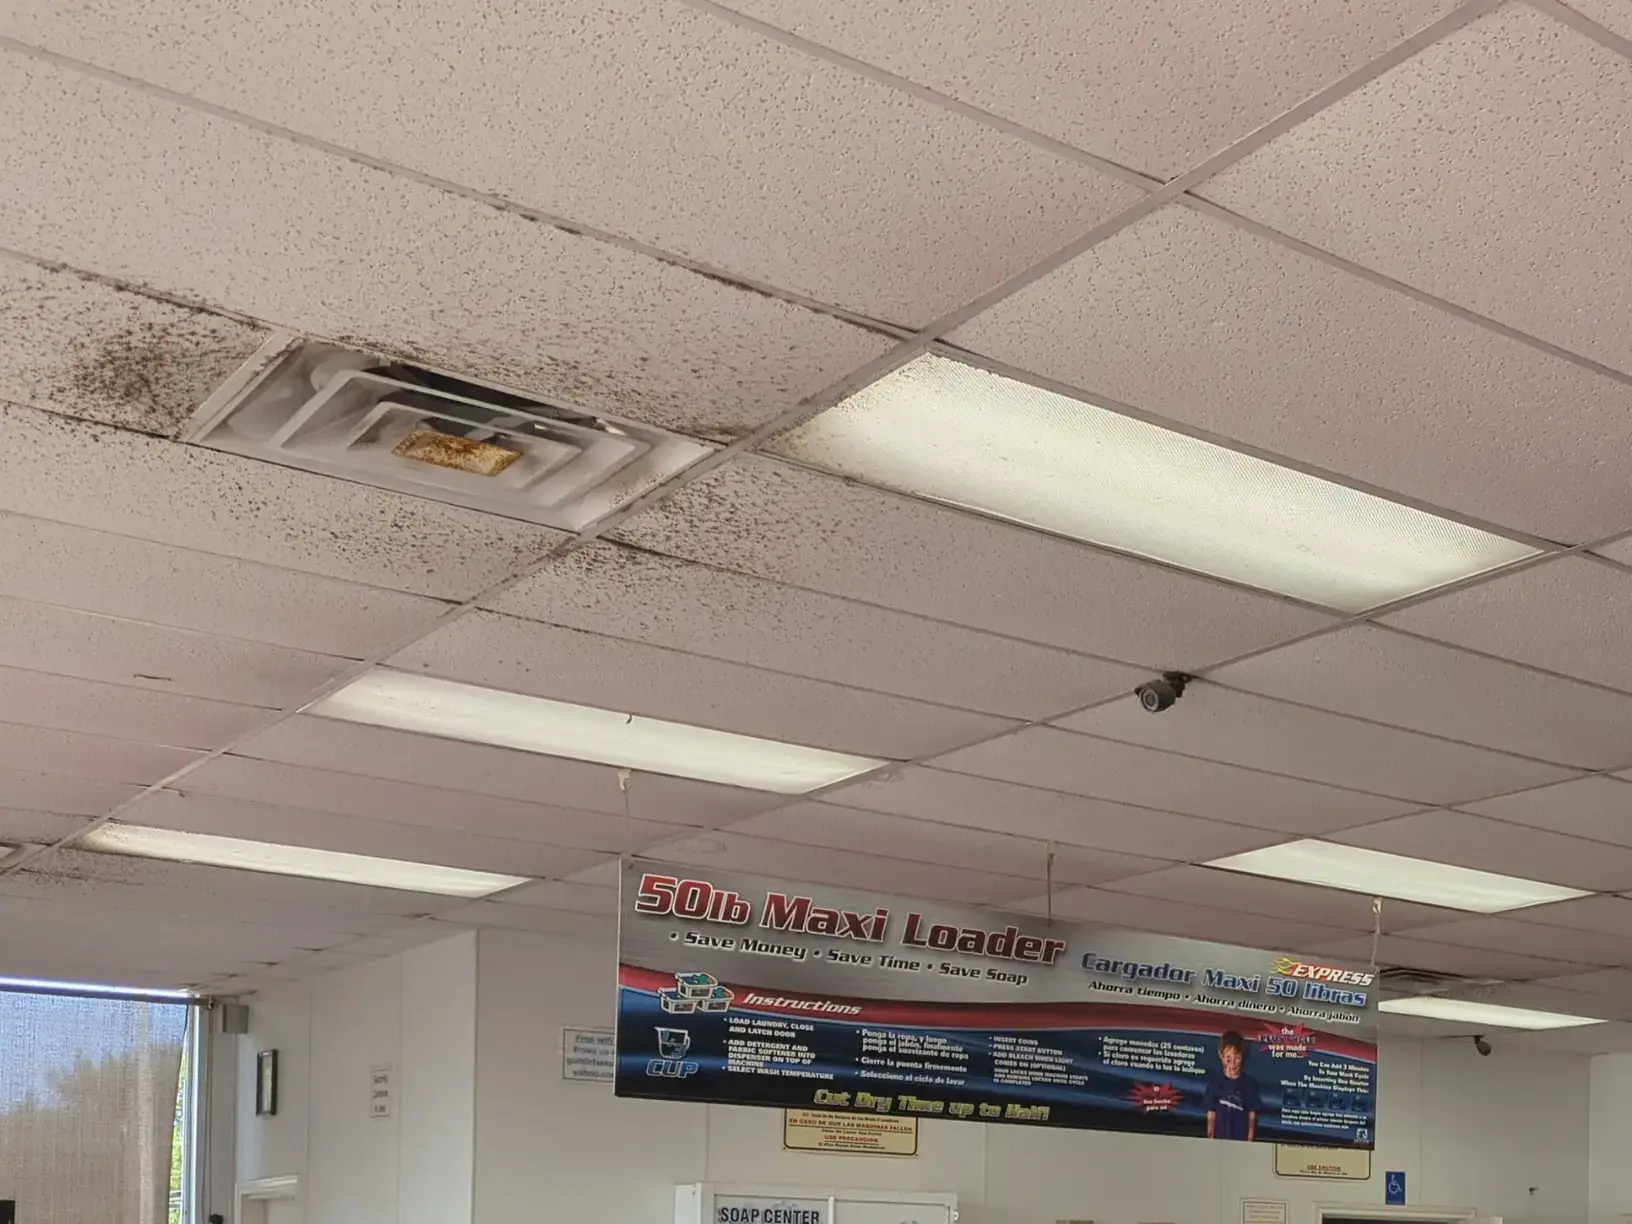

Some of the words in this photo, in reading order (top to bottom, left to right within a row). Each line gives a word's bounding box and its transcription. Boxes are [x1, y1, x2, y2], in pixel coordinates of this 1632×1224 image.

[635, 873, 751, 925] 50lb
[759, 892, 890, 943] Maxi
[901, 911, 1065, 965] Loader
[684, 931, 734, 949] Save
[739, 938, 807, 961] Money
[827, 948, 872, 965] Save
[879, 955, 920, 971] Time
[939, 962, 980, 978] Save
[986, 968, 1028, 985] Soap
[1081, 953, 1195, 985] Cargador
[1203, 968, 1260, 993] Maxi
[1266, 976, 1298, 998] 50
[1303, 982, 1367, 1007] libras
[1292, 964, 1375, 986] EXPRESS
[742, 992, 862, 1016] Instructions
[1088, 979, 1133, 995] Ahorra
[1137, 986, 1180, 1001] tiempo
[1193, 993, 1235, 1008] Ahorra
[1238, 1000, 1276, 1012] dinero
[1287, 1005, 1326, 1019] Ahorra
[646, 1059, 698, 1079] CUP
[814, 1088, 851, 1107] Cut
[854, 1092, 892, 1112] Dry
[898, 1094, 945, 1113] Time
[949, 1102, 975, 1118] up
[979, 1103, 1001, 1118] to
[720, 1207, 759, 1224] SOAP
[764, 1209, 820, 1224] CENTER
